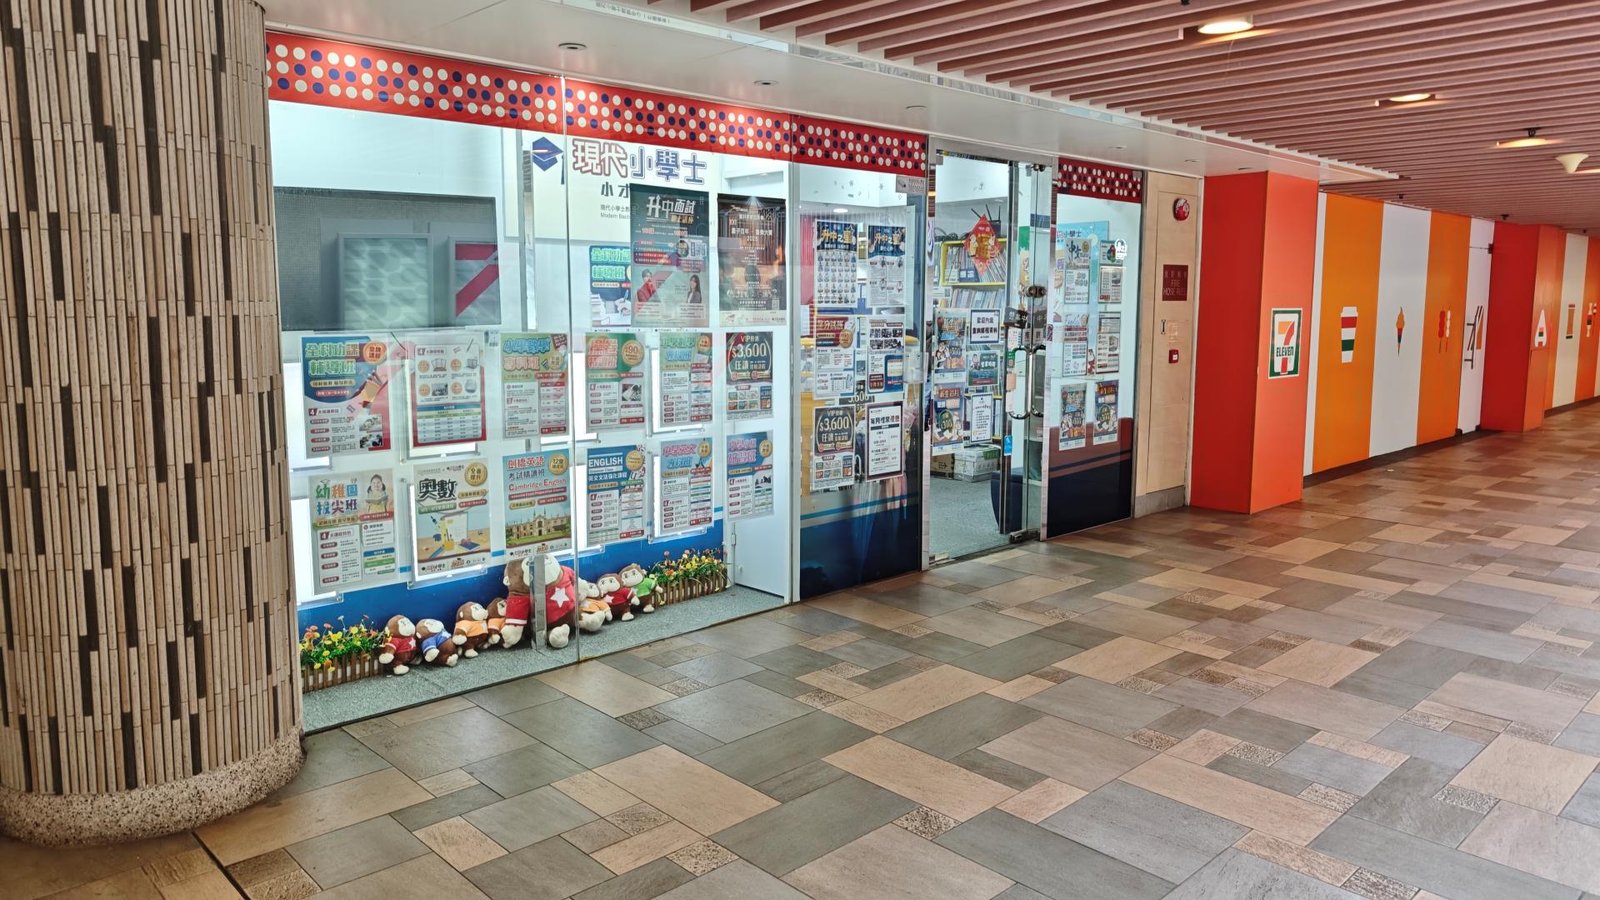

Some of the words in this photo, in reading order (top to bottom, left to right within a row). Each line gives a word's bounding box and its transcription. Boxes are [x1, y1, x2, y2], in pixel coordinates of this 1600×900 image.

[572, 138, 707, 185] 現代小學士
[646, 194, 696, 219] 升中面試
[732, 343, 767, 359] $3,600
[819, 416, 850, 432] $3,600
[588, 456, 623, 468] ENGLISH
[315, 483, 358, 500] 幼稚園
[418, 477, 457, 500] 奧數
[508, 481, 542, 491] Cambridge
